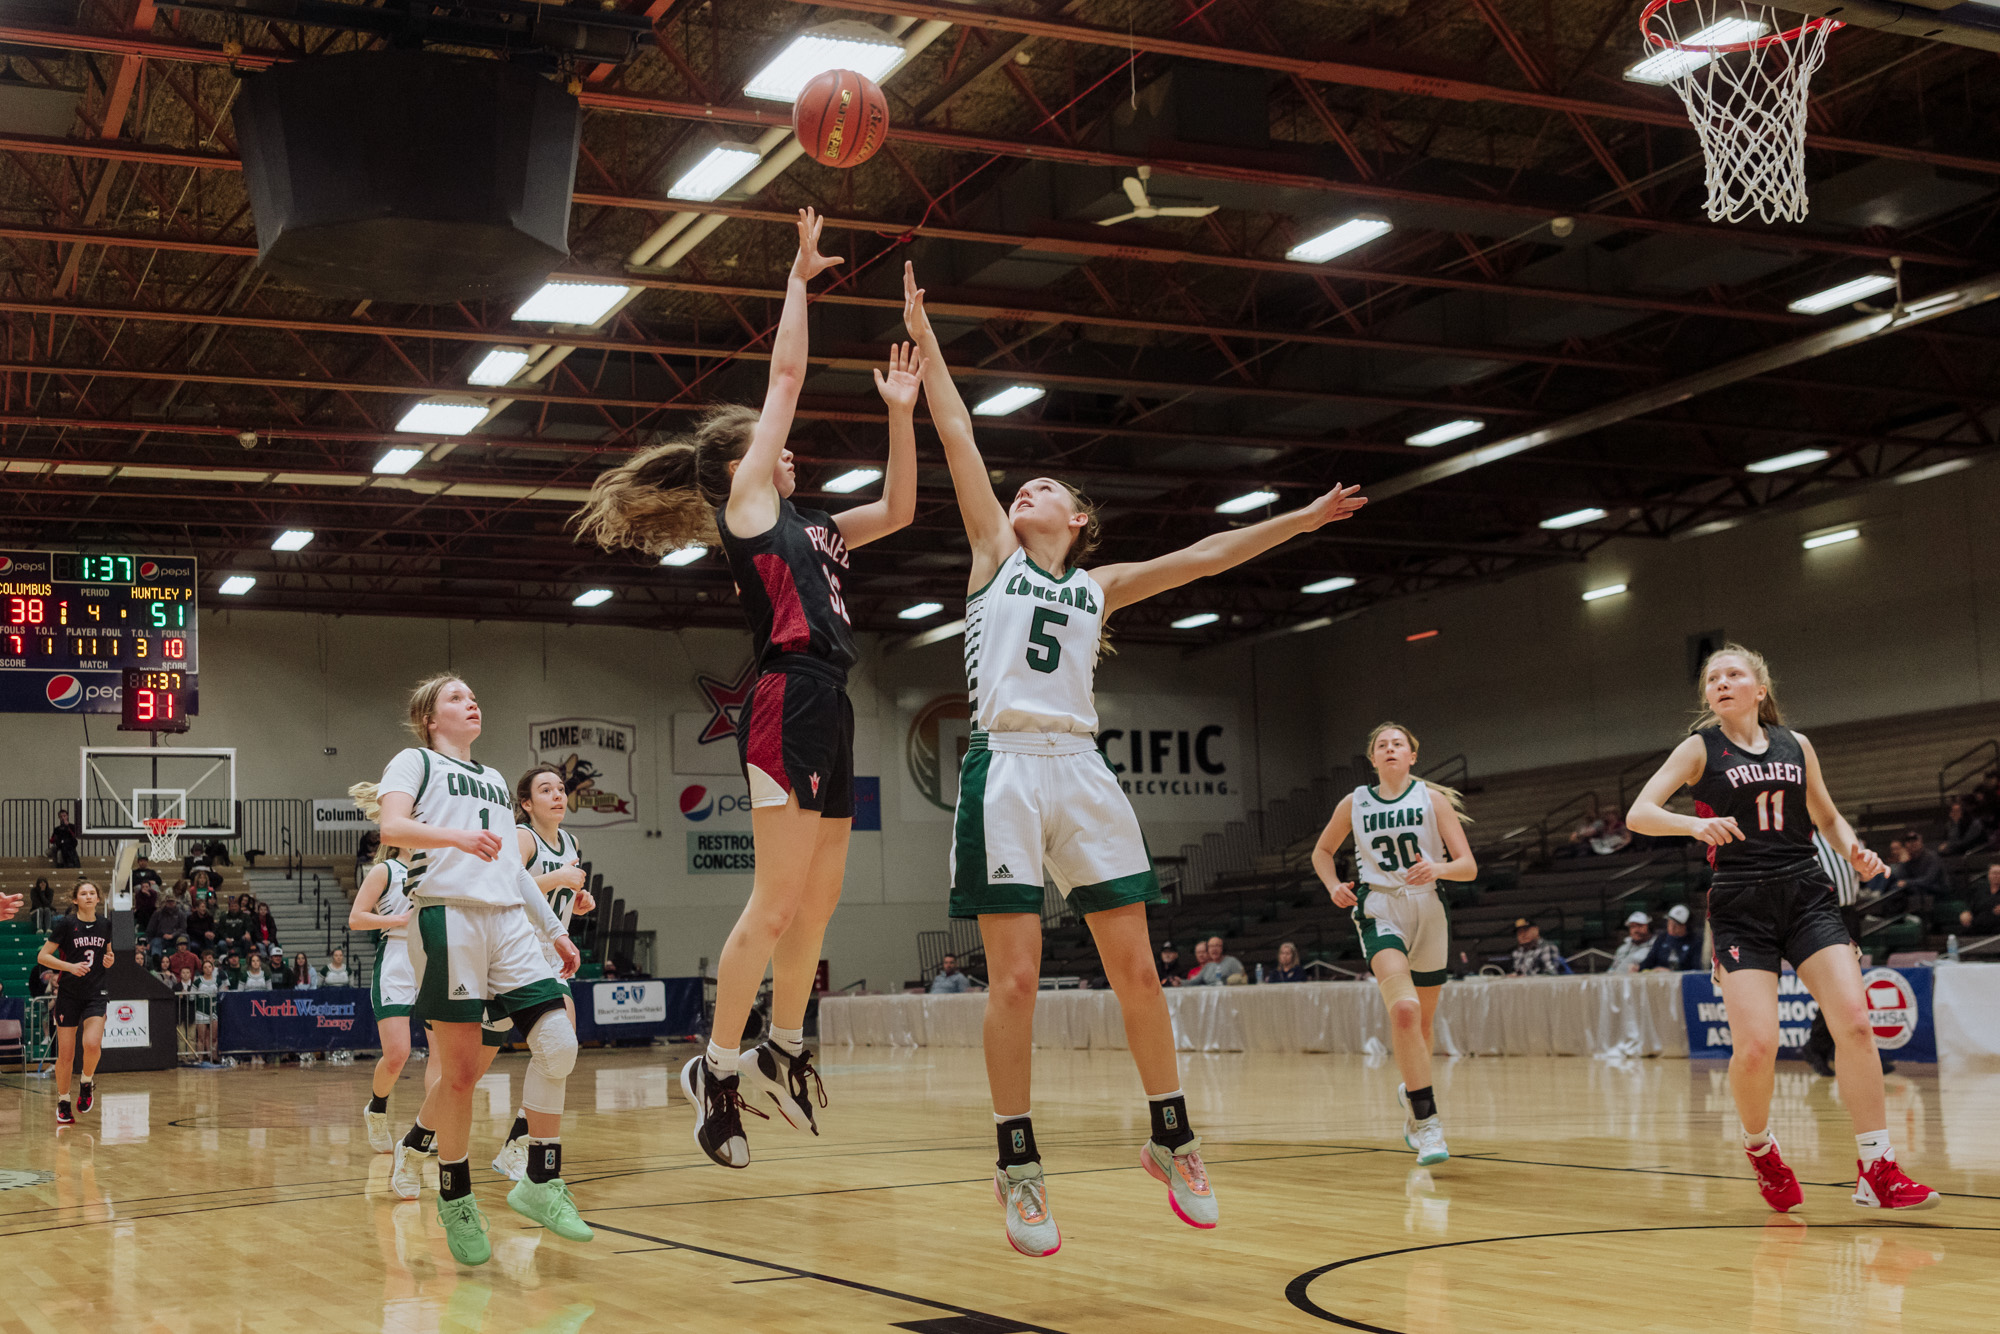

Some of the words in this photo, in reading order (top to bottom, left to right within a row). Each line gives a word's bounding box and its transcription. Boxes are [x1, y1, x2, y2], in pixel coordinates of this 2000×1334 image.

[832, 89, 852, 141] ELITE
[825, 137, 841, 159] PRO
[15, 562, 46, 572] pepsi
[84, 556, 131, 581] 1:37
[161, 567, 190, 577] pepsi
[81, 588, 110, 597] PERIOD
[131, 587, 179, 600] HUNTLEY
[185, 588, 192, 600] P
[1005, 573, 1098, 615] COUGARS
[11, 598, 43, 624] 38
[87, 604, 100, 621] 4
[151, 602, 183, 627] 51
[0, 625, 26, 634] FOULS
[35, 626, 57, 635] T.O.L.
[66, 627, 97, 636] PLAYER
[101, 628, 122, 637] FOUL
[131, 629, 153, 638] T.O.L.
[162, 630, 187, 638] FOULS
[10, 635, 21, 654] 7
[137, 638, 148, 658] 3
[165, 638, 183, 658] 10
[1026, 606, 1069, 674] 5
[0, 659, 26, 667] SCORE
[80, 660, 108, 669] MATCH
[162, 662, 187, 671] SCORE
[147, 672, 180, 690] 1:37
[86, 686, 122, 701] pep
[138, 690, 173, 719] 31
[540, 726, 579, 750] HOME
[581, 728, 592, 740] OF
[596, 728, 625, 752] THE
[1097, 725, 1226, 775] CIFIC
[1725, 762, 1802, 789] PROJECT
[1123, 781, 1228, 795] RECYCLING
[316, 808, 372, 822] Columb
[479, 807, 490, 830] 1
[1755, 790, 1785, 831] 11
[1363, 807, 1424, 834] COUGARS
[699, 835, 755, 850] RESTRO
[1371, 832, 1423, 872] 30
[693, 854, 755, 869] CONCESS
[73, 936, 106, 949] PROJECT
[84, 949, 95, 967] 3
[251, 999, 355, 1017] NorthWestern
[1697, 1002, 1728, 1022] HIG
[104, 1026, 147, 1037] LOGAN
[317, 1015, 354, 1031] Energy
